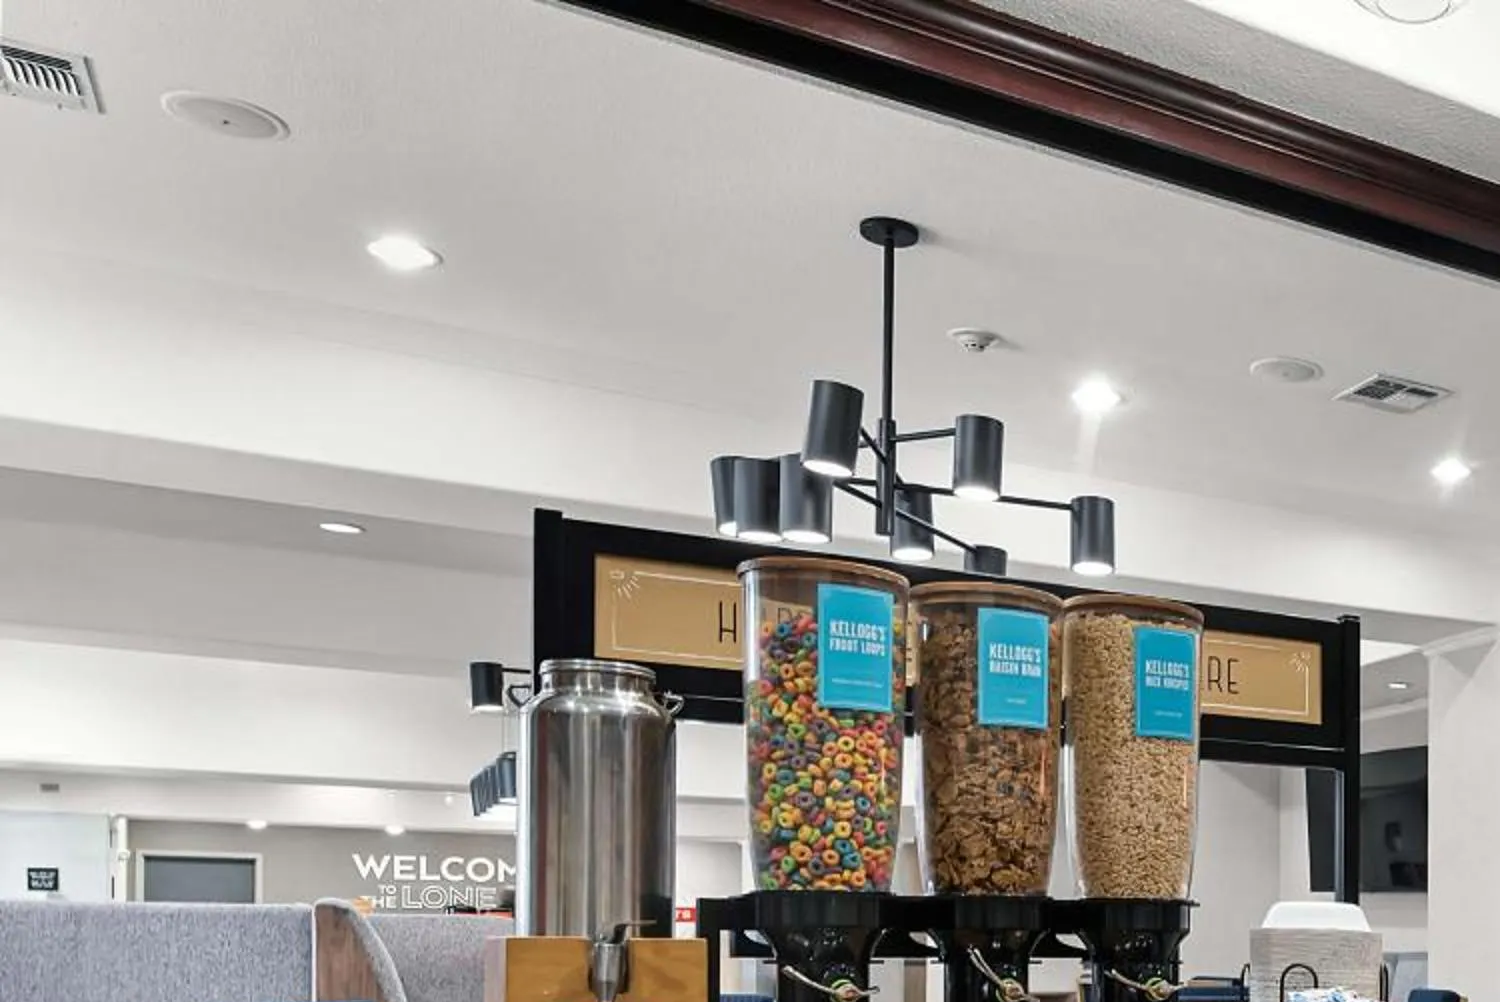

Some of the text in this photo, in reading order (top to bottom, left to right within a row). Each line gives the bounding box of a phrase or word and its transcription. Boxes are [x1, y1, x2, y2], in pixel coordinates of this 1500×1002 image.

[829, 620, 887, 641] KELLOGG'S
[861, 641, 886, 657] LOOPS
[989, 643, 1041, 663] KELLOGG'S
[379, 884, 396, 895] TO
[402, 885, 497, 909] LONE
